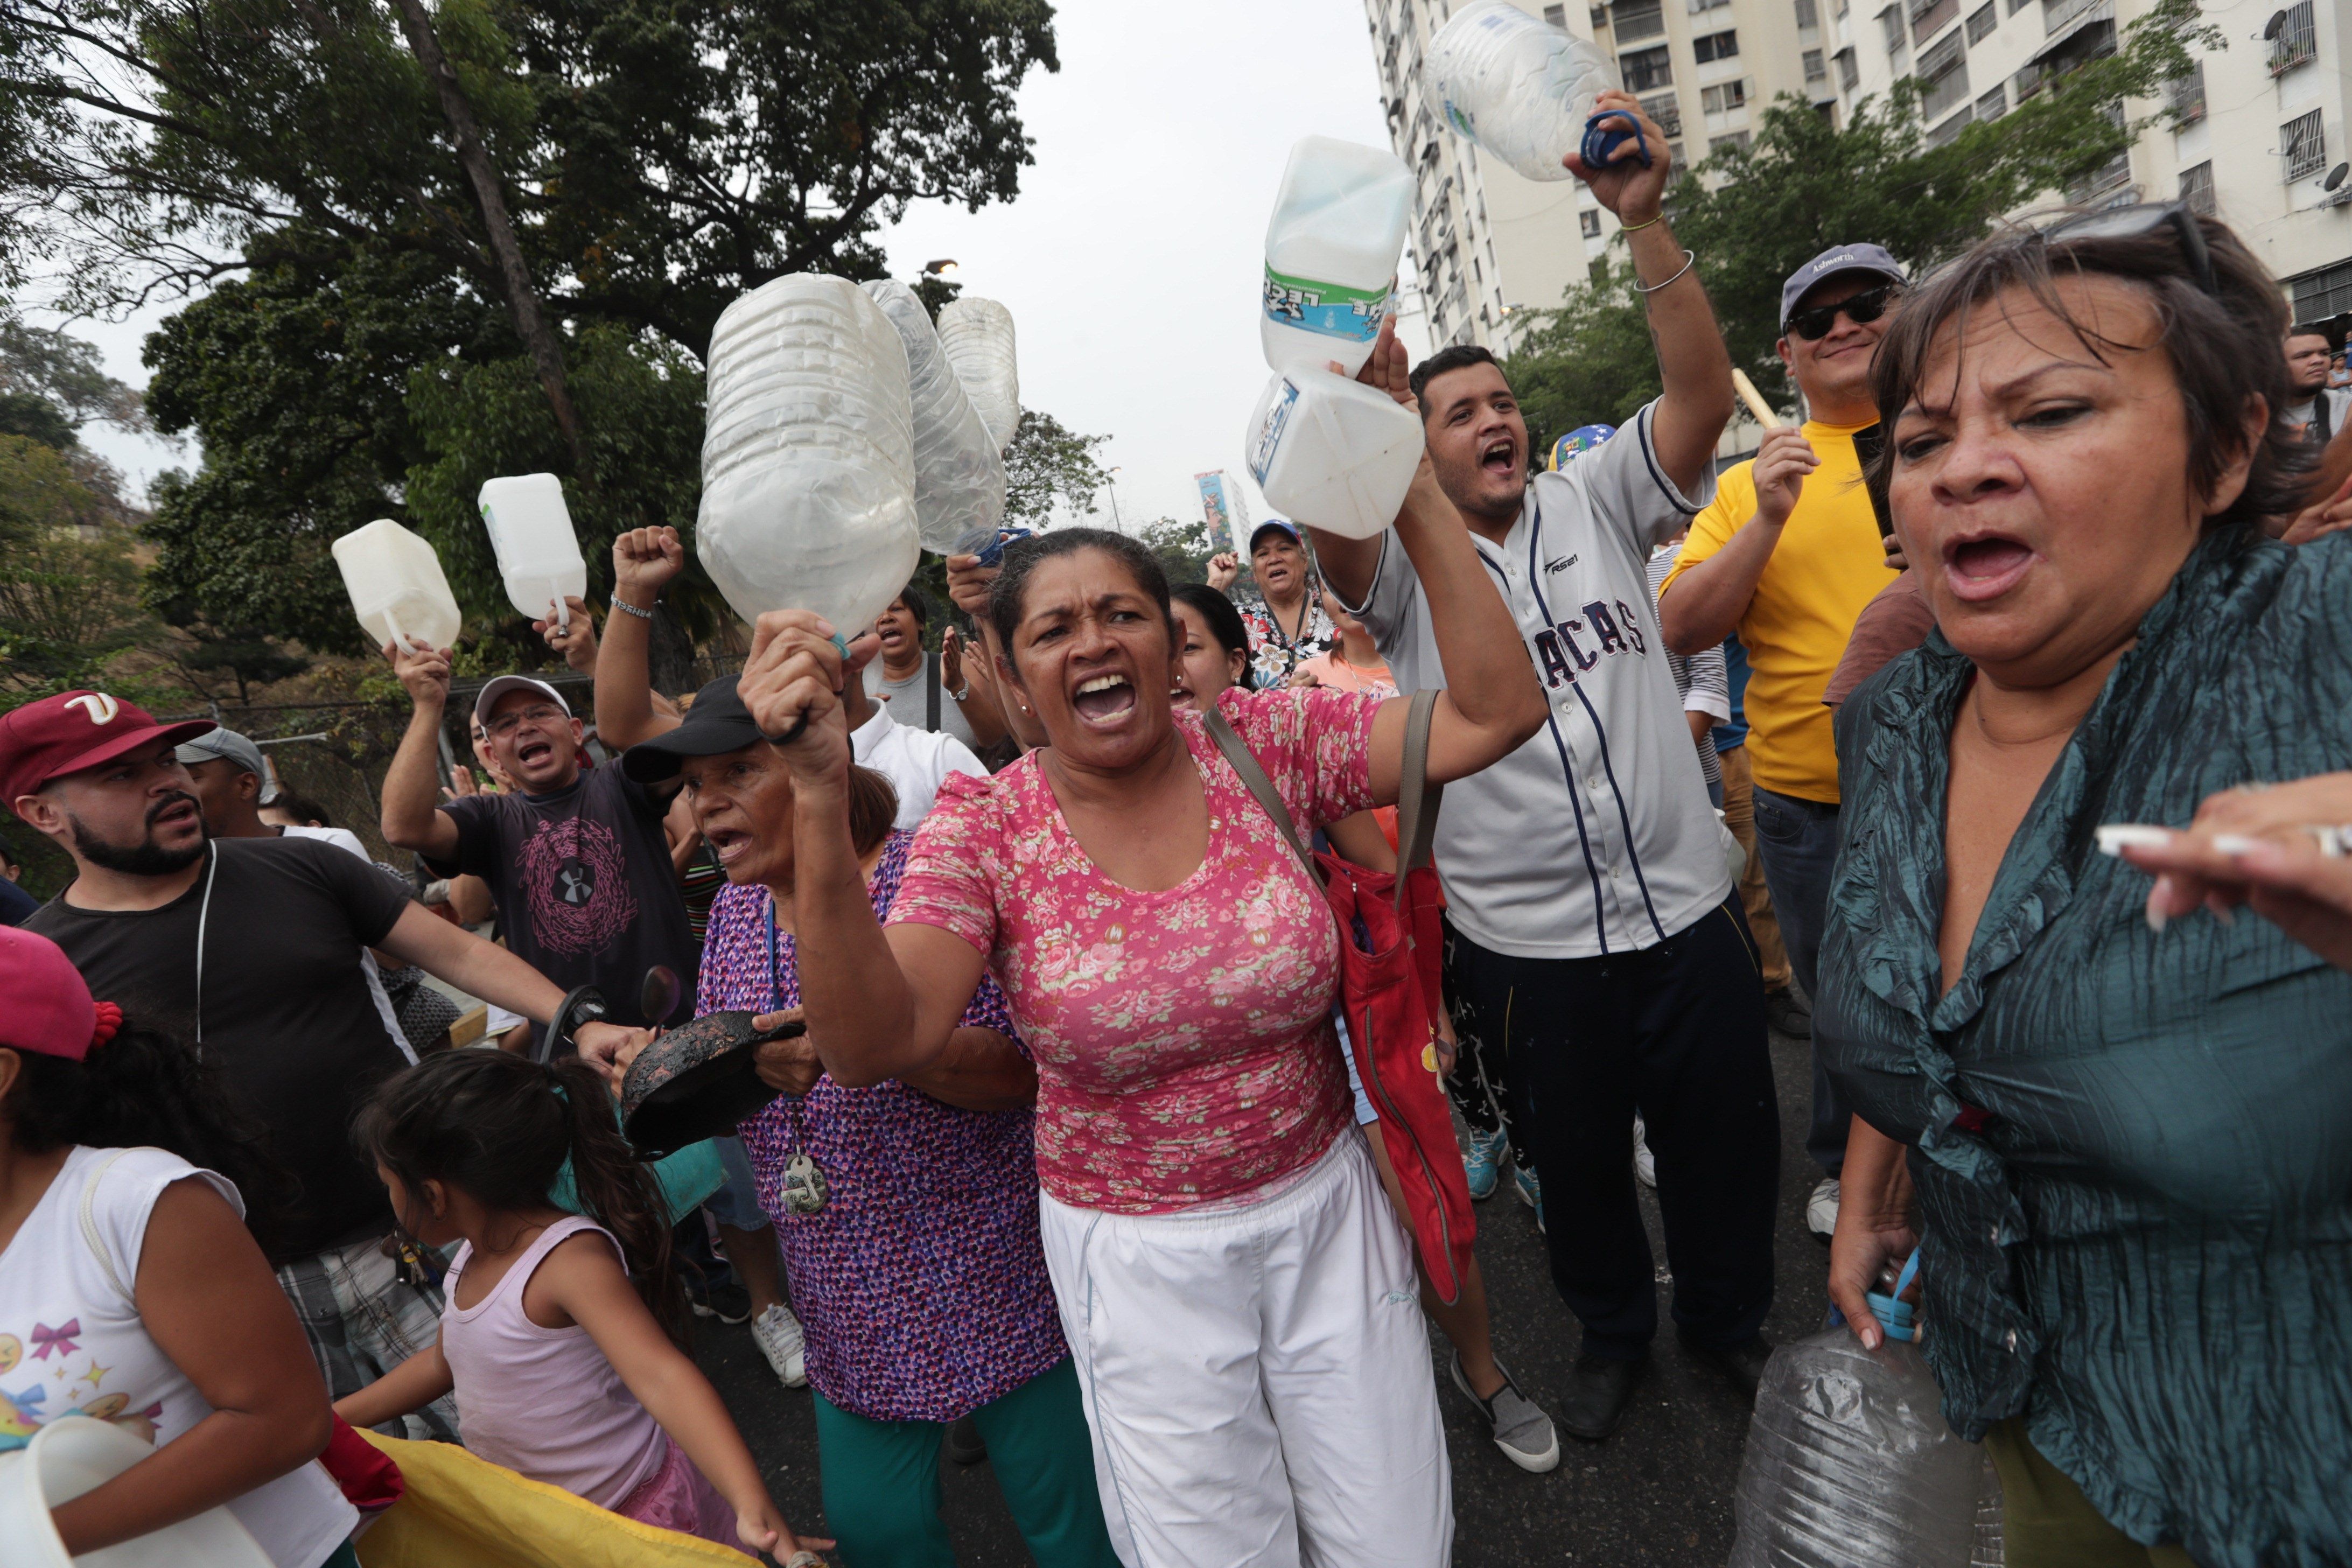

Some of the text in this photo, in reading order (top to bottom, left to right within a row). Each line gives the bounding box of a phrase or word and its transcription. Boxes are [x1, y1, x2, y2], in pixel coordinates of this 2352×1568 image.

[1812, 253, 1854, 275] Ashworth
[1551, 554, 1578, 575] RS21
[1534, 596, 1647, 691] ACAS
